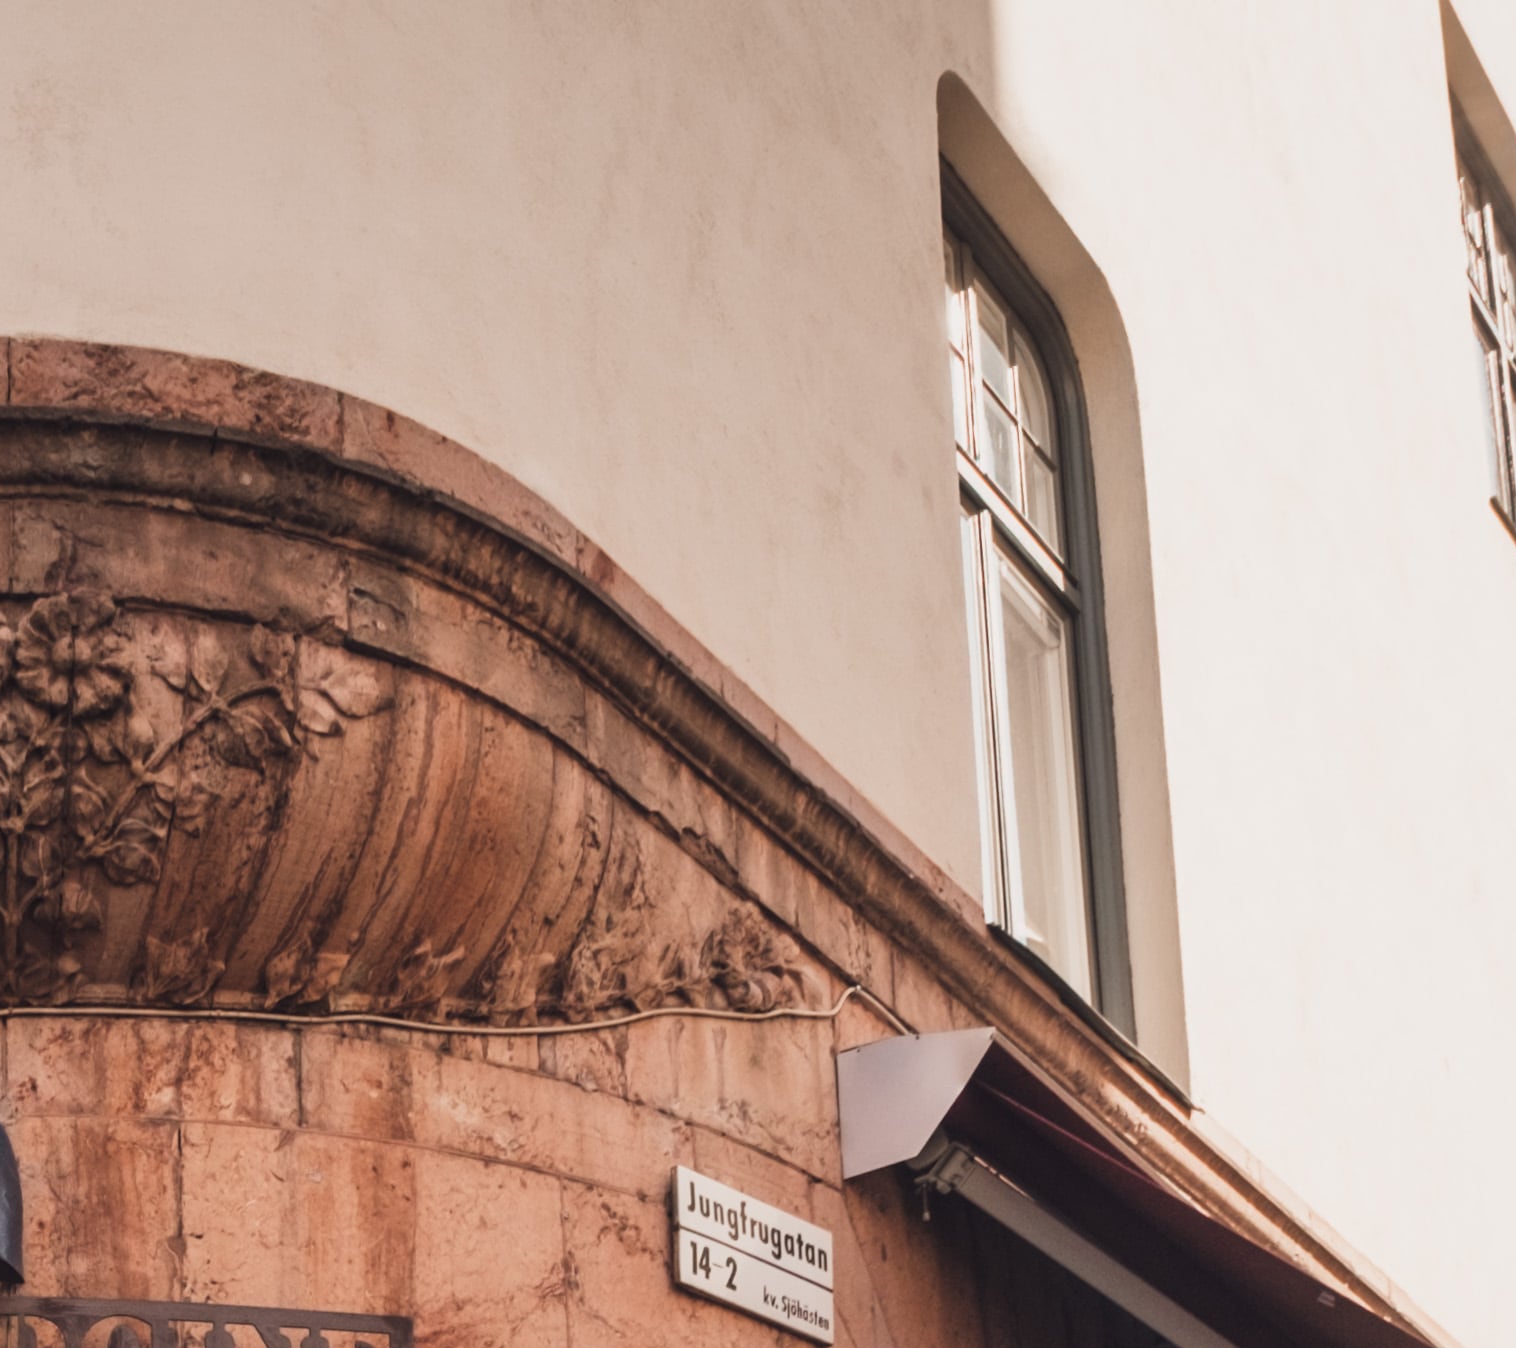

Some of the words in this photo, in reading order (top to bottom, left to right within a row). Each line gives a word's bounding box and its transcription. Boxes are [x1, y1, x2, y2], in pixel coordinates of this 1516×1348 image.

[687, 1181, 828, 1273] Jungfrugatan
[763, 1285, 779, 1311] kv.
[781, 1295, 830, 1331] Sjöhästen
